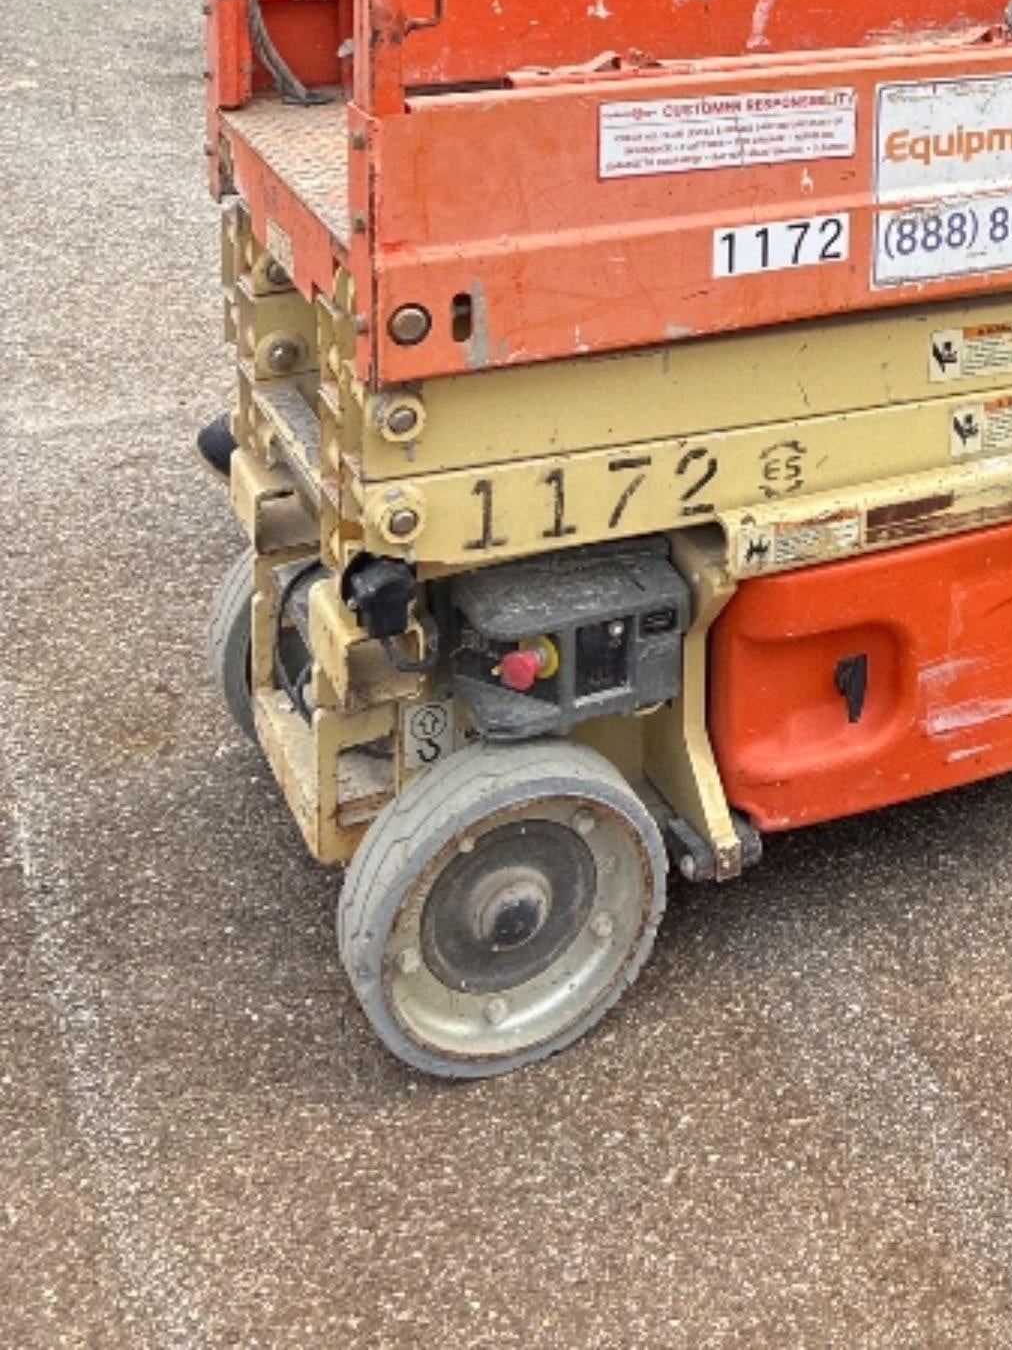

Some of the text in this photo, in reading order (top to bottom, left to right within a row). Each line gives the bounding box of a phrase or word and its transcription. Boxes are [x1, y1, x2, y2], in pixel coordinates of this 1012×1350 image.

[720, 217, 843, 274] 1172
[884, 208, 979, 260] (888)
[463, 447, 719, 551] 1172
